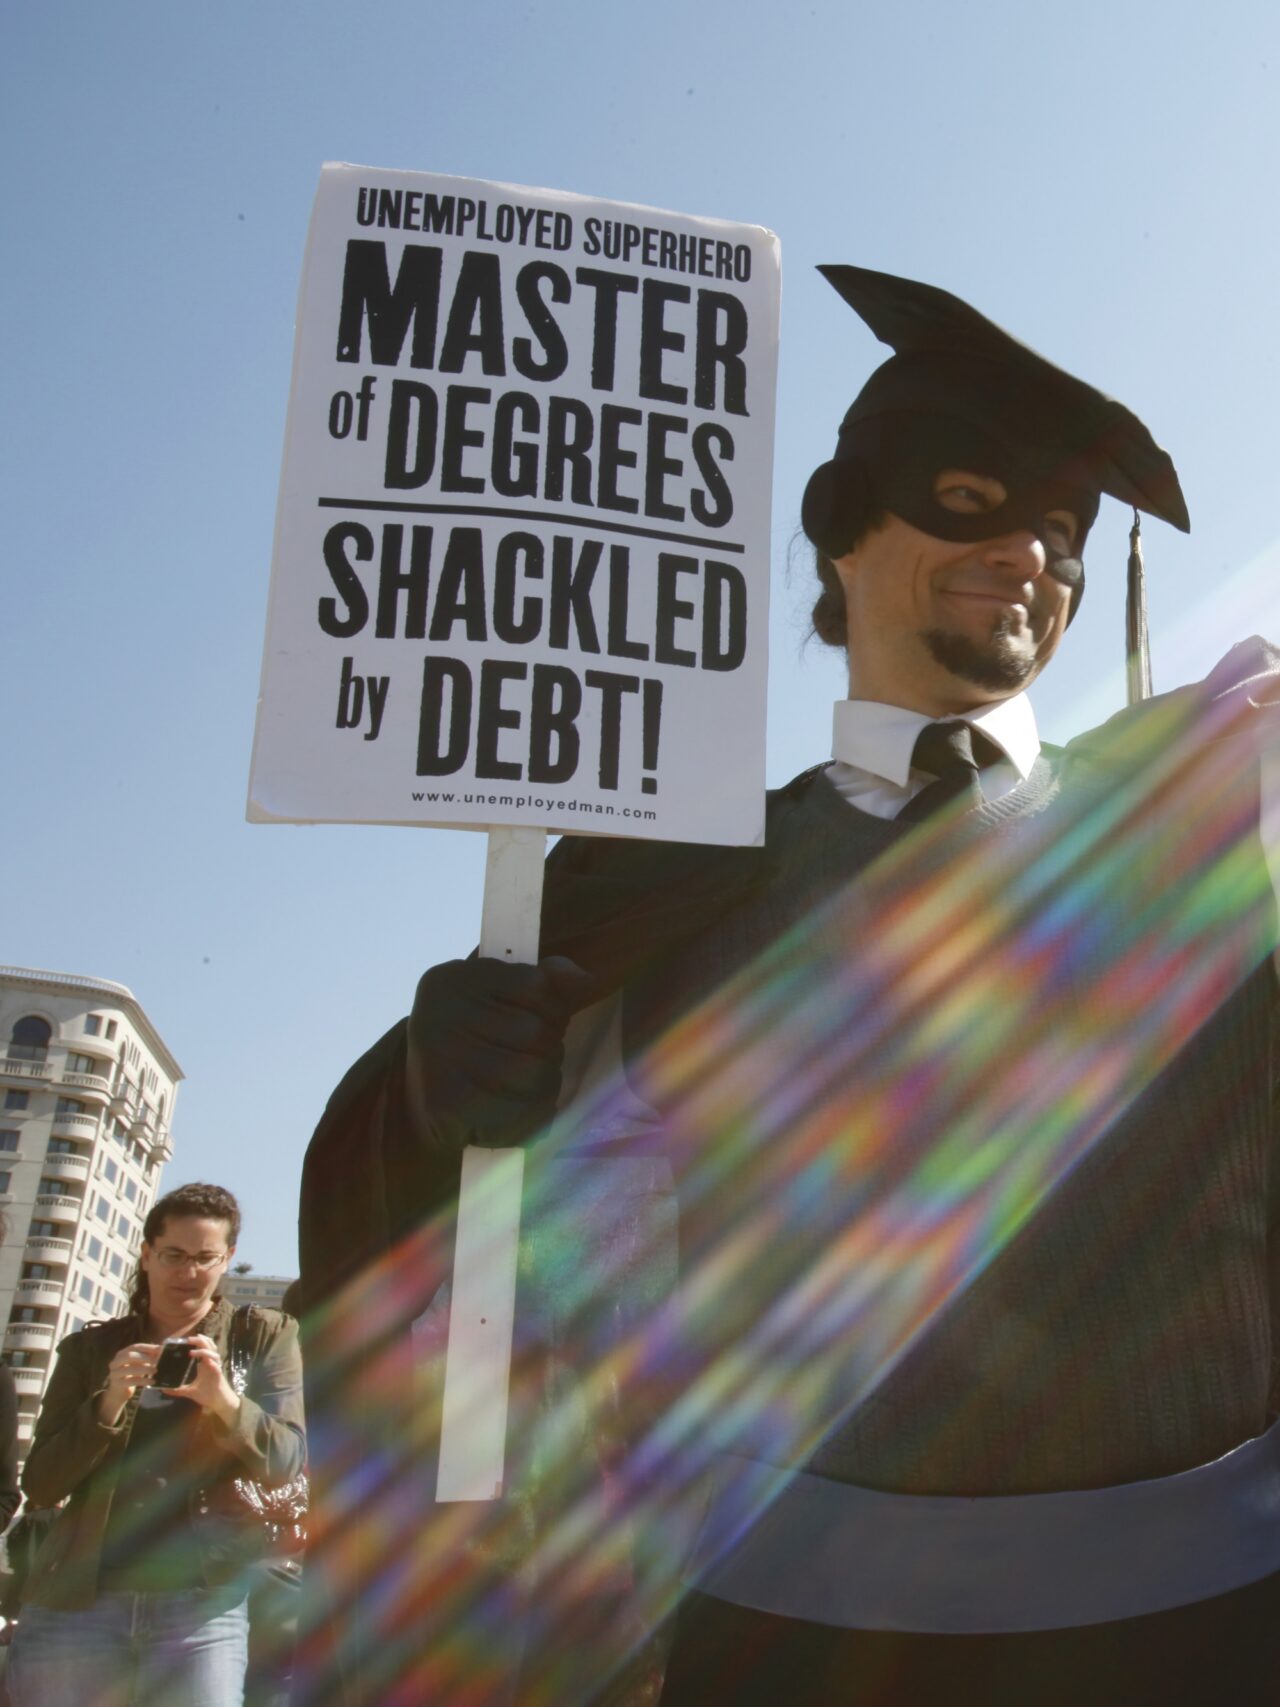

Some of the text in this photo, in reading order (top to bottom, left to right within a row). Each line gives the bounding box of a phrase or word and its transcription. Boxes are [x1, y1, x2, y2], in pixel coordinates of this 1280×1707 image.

[356, 187, 752, 283] UNEMPLOYED SUPERHERO
[336, 239, 750, 418] MASTER
[328, 376, 735, 529] of DEGREES
[318, 521, 747, 672] SHACKLED
[335, 655, 664, 795] by DEBT!
[411, 793, 658, 821] www.unemployedman.com
